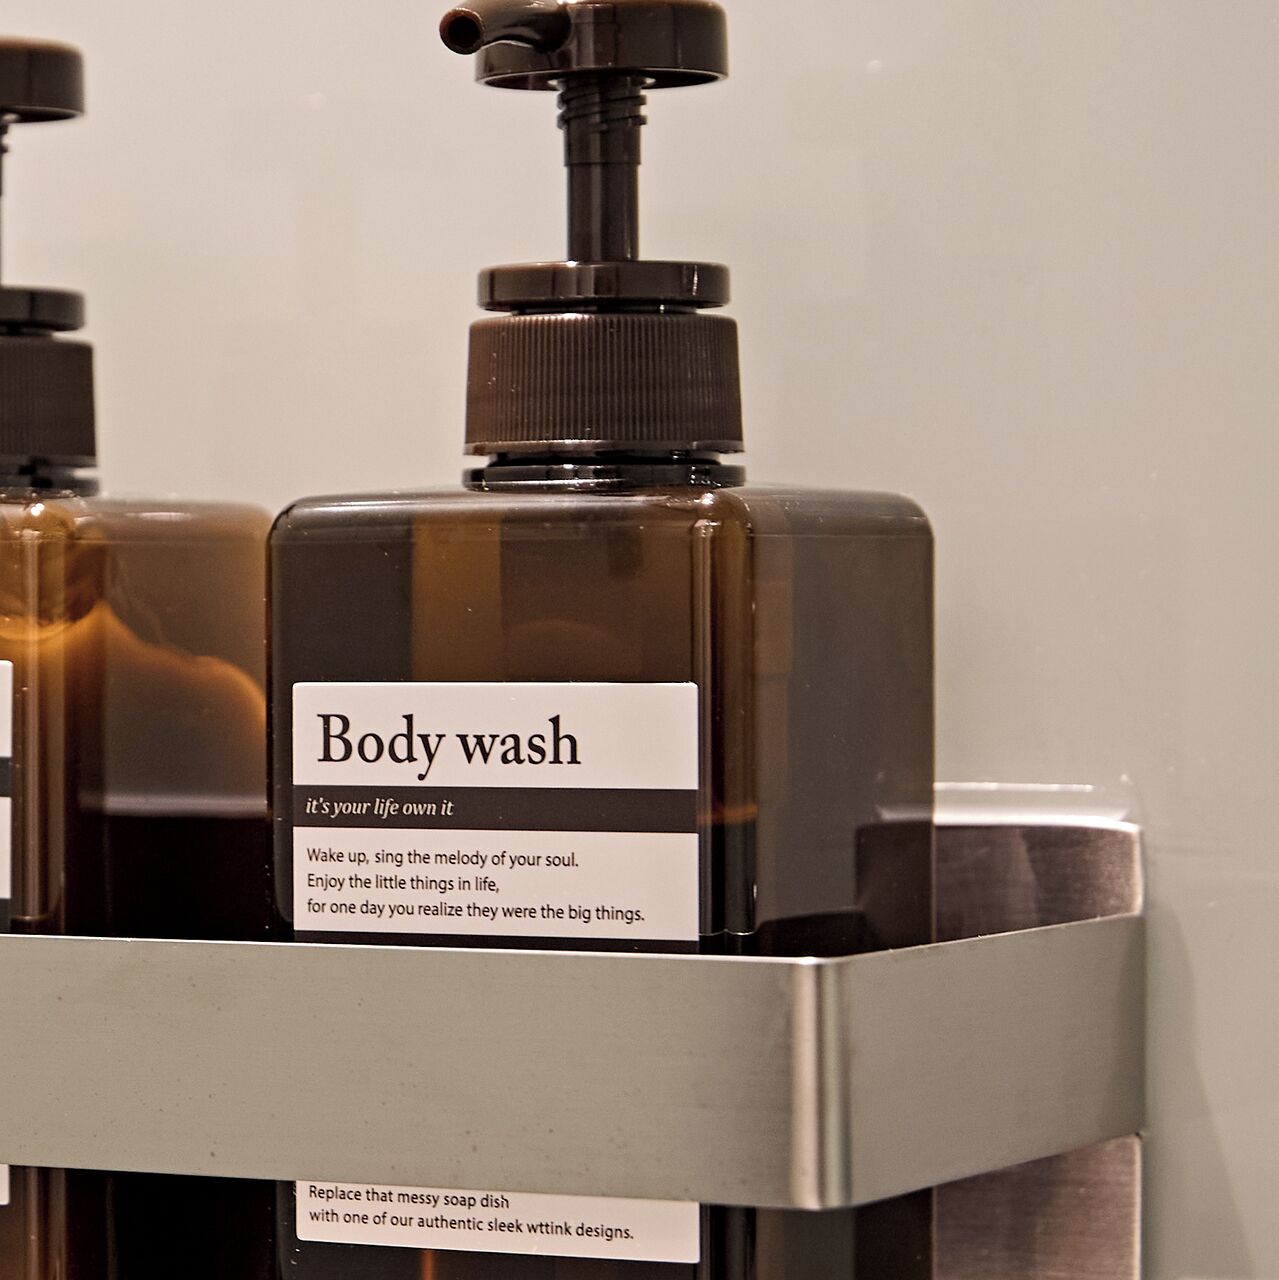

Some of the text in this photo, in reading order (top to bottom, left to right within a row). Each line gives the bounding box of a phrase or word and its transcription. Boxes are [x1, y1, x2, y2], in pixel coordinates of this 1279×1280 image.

[316, 713, 582, 782] Body wash
[305, 797, 455, 820] it's your life own it
[306, 847, 579, 870] Wake up, sing the melody of your soul.
[307, 873, 500, 895] Enjoy the little things in life,
[307, 897, 645, 925] for one day you realize they were the big things.
[309, 1184, 510, 1211] Replace that messy soap dish
[309, 1208, 634, 1242] with one of our authentic sleek wttink designs.
